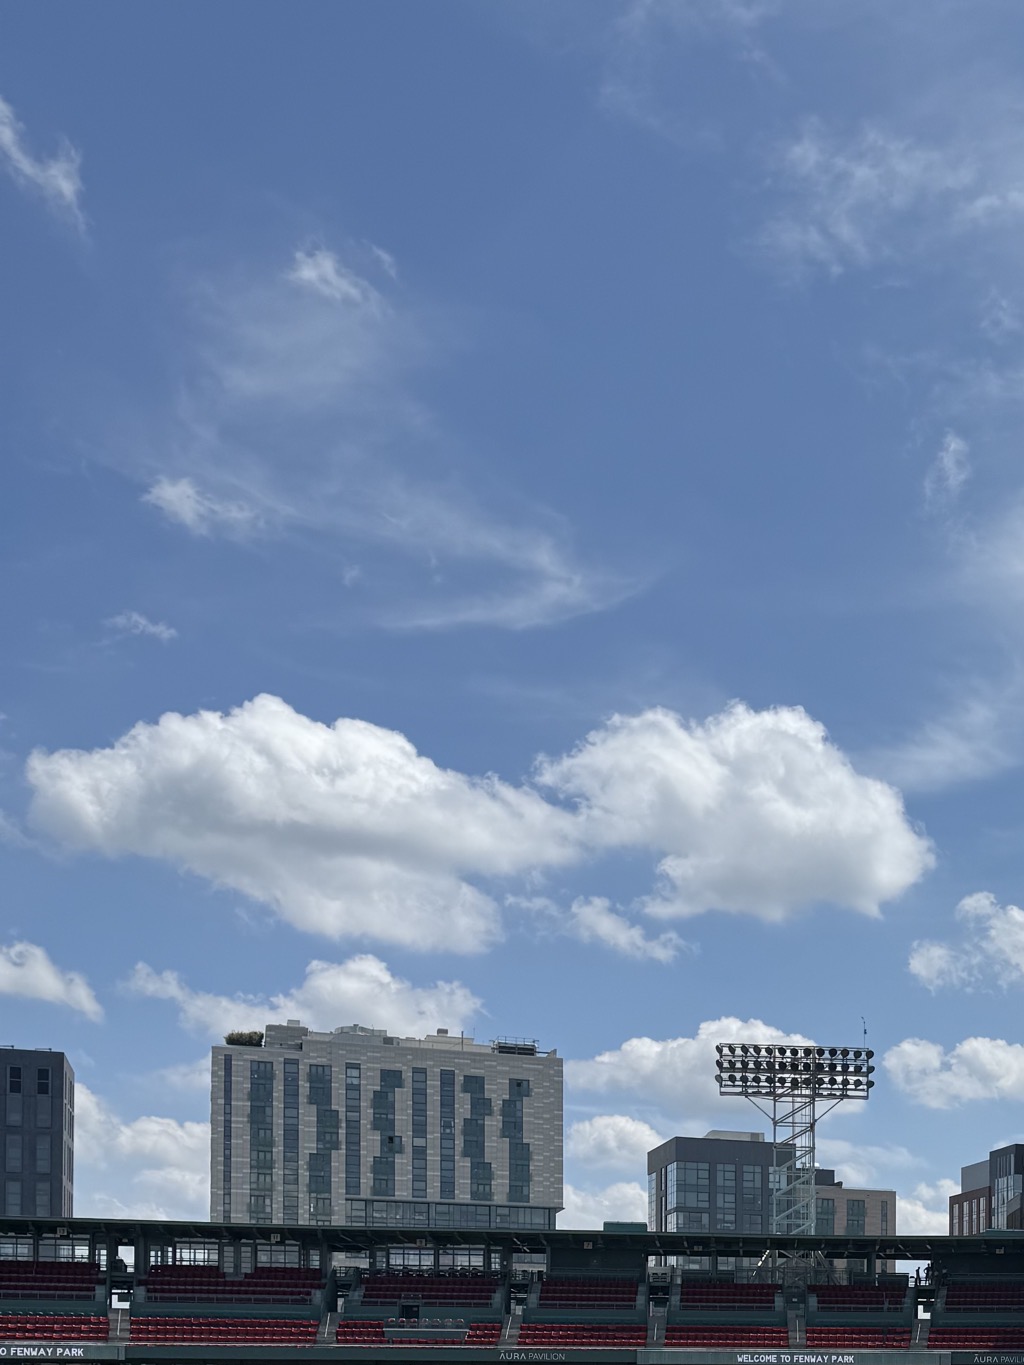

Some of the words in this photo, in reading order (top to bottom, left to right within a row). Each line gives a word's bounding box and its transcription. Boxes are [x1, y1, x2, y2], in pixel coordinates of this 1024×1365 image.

[10, 1347, 53, 1356] FENWAY
[56, 1347, 84, 1357] PARK
[528, 1352, 566, 1361] PAVILION
[737, 1354, 777, 1363] WELCOME
[780, 1354, 791, 1363] TO
[793, 1354, 829, 1363] FENWAY
[831, 1354, 854, 1363] PARK
